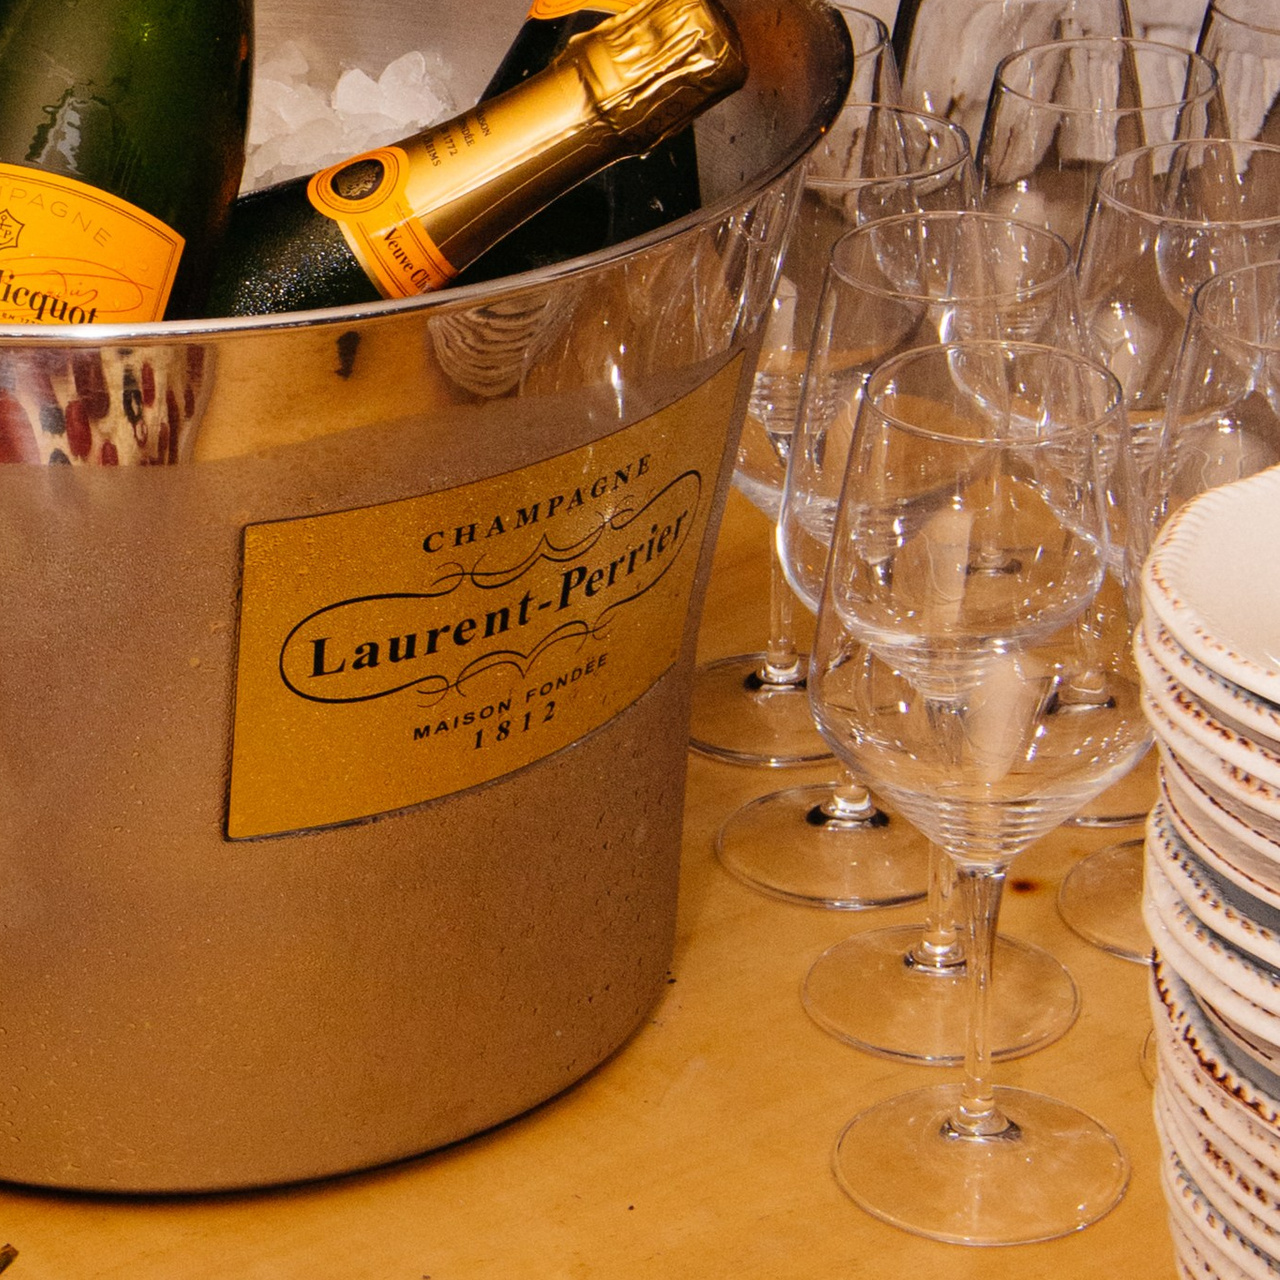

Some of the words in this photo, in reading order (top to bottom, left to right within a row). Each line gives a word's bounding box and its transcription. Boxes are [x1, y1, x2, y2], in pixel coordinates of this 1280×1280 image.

[384, 227, 414, 273] Veuve
[422, 453, 653, 554] CHAMPAGNE
[307, 509, 689, 678] Laurent-Perrier
[413, 698, 512, 741] MAISON
[473, 700, 556, 750] 1812
